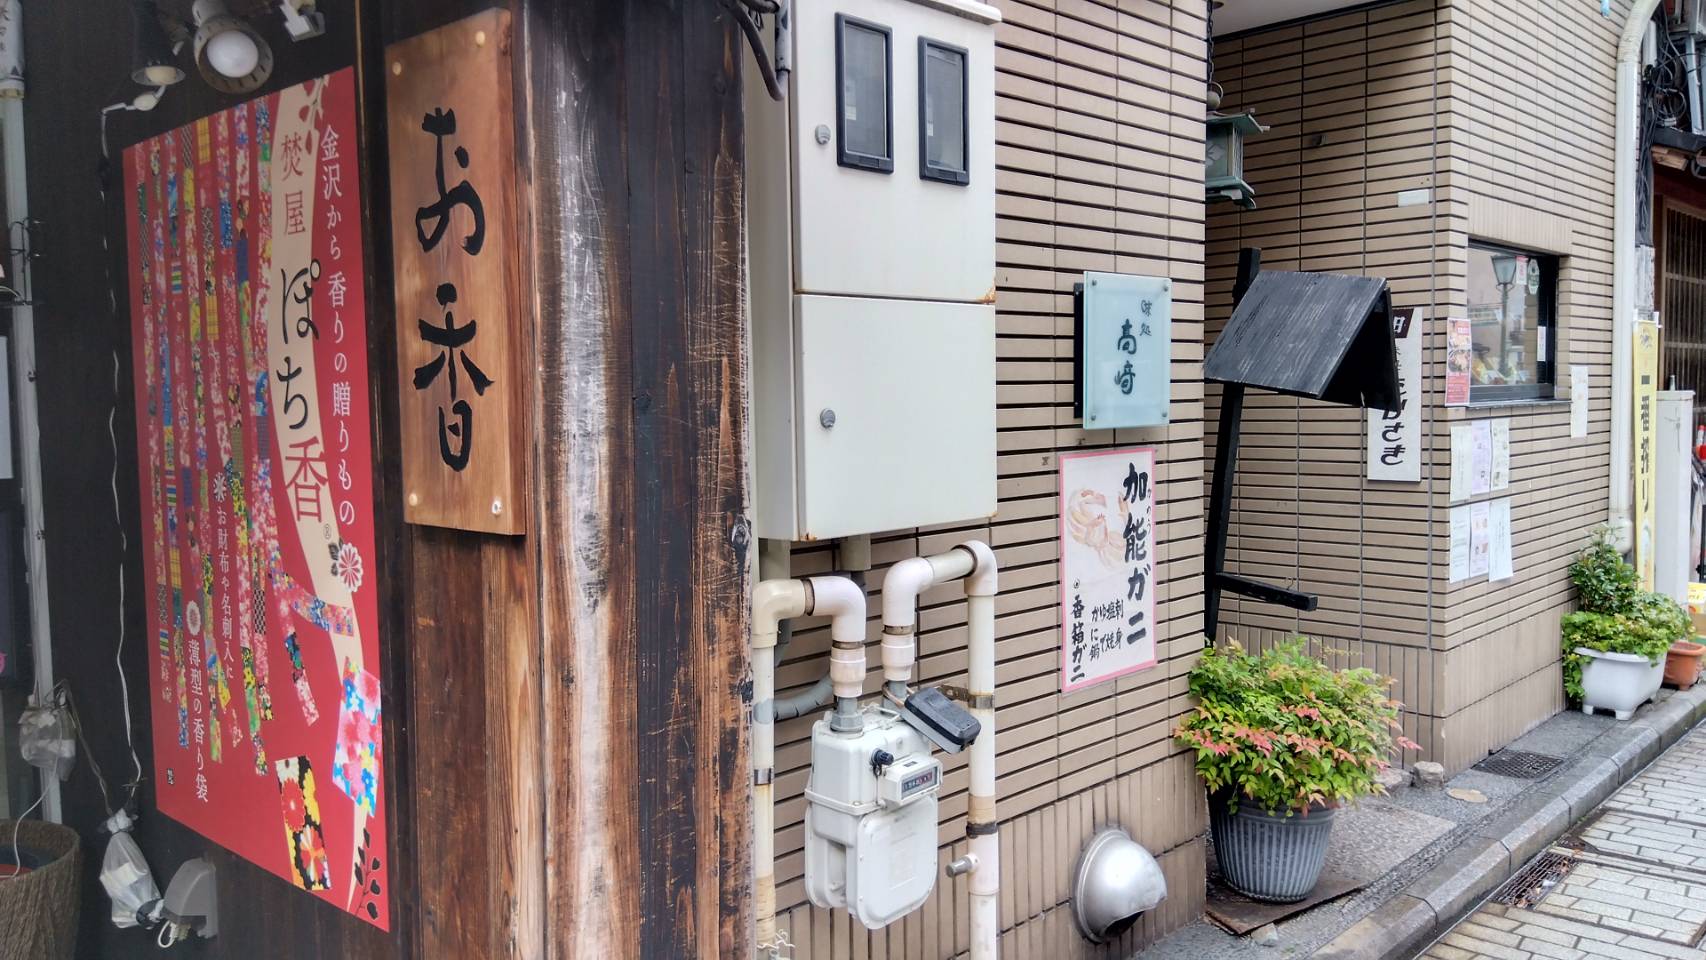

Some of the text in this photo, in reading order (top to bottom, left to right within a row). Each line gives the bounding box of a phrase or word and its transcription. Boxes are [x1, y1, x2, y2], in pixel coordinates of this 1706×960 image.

[281, 132, 306, 236] 焚屋
[320, 123, 356, 526] 金沢から香りの贈りもの
[413, 106, 495, 473] お香
[1139, 299, 1153, 337] 味処
[1122, 462, 1151, 645] 加能ガニ
[187, 638, 208, 803] 薄型の香り袋
